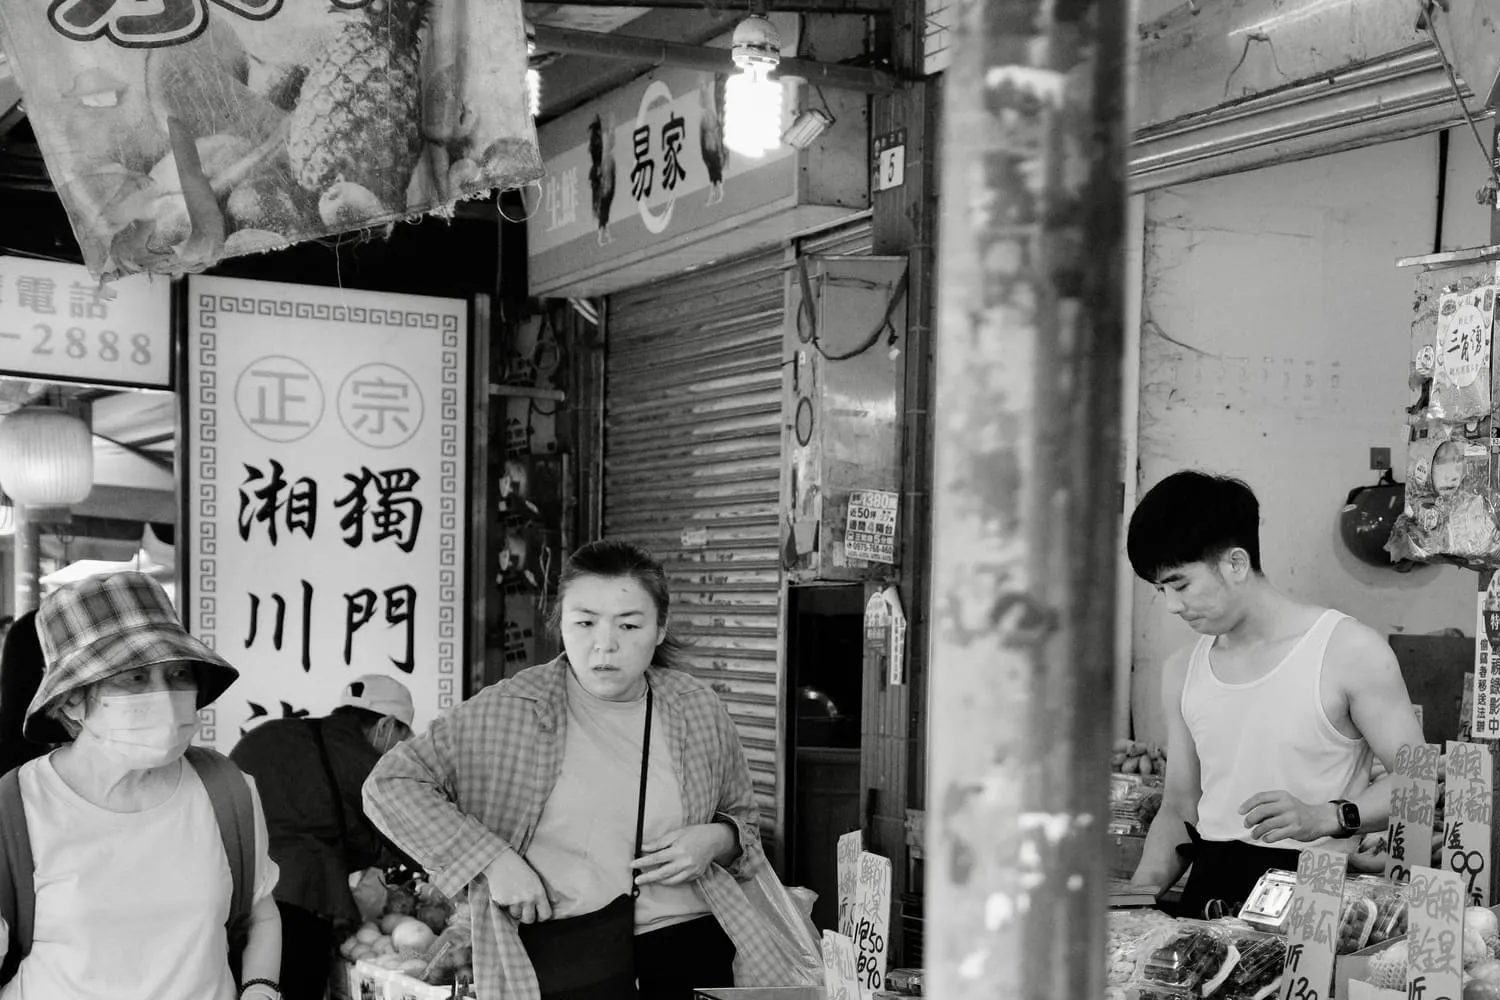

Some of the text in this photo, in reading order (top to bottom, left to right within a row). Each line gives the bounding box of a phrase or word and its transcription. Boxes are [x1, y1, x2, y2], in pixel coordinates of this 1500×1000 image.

[630, 111, 686, 201] 易家
[888, 151, 896, 183] 5
[0, 276, 110, 320] 電話
[250, 369, 410, 435] 正宗
[238, 458, 319, 722] 湘川
[333, 465, 424, 675] 獨門
